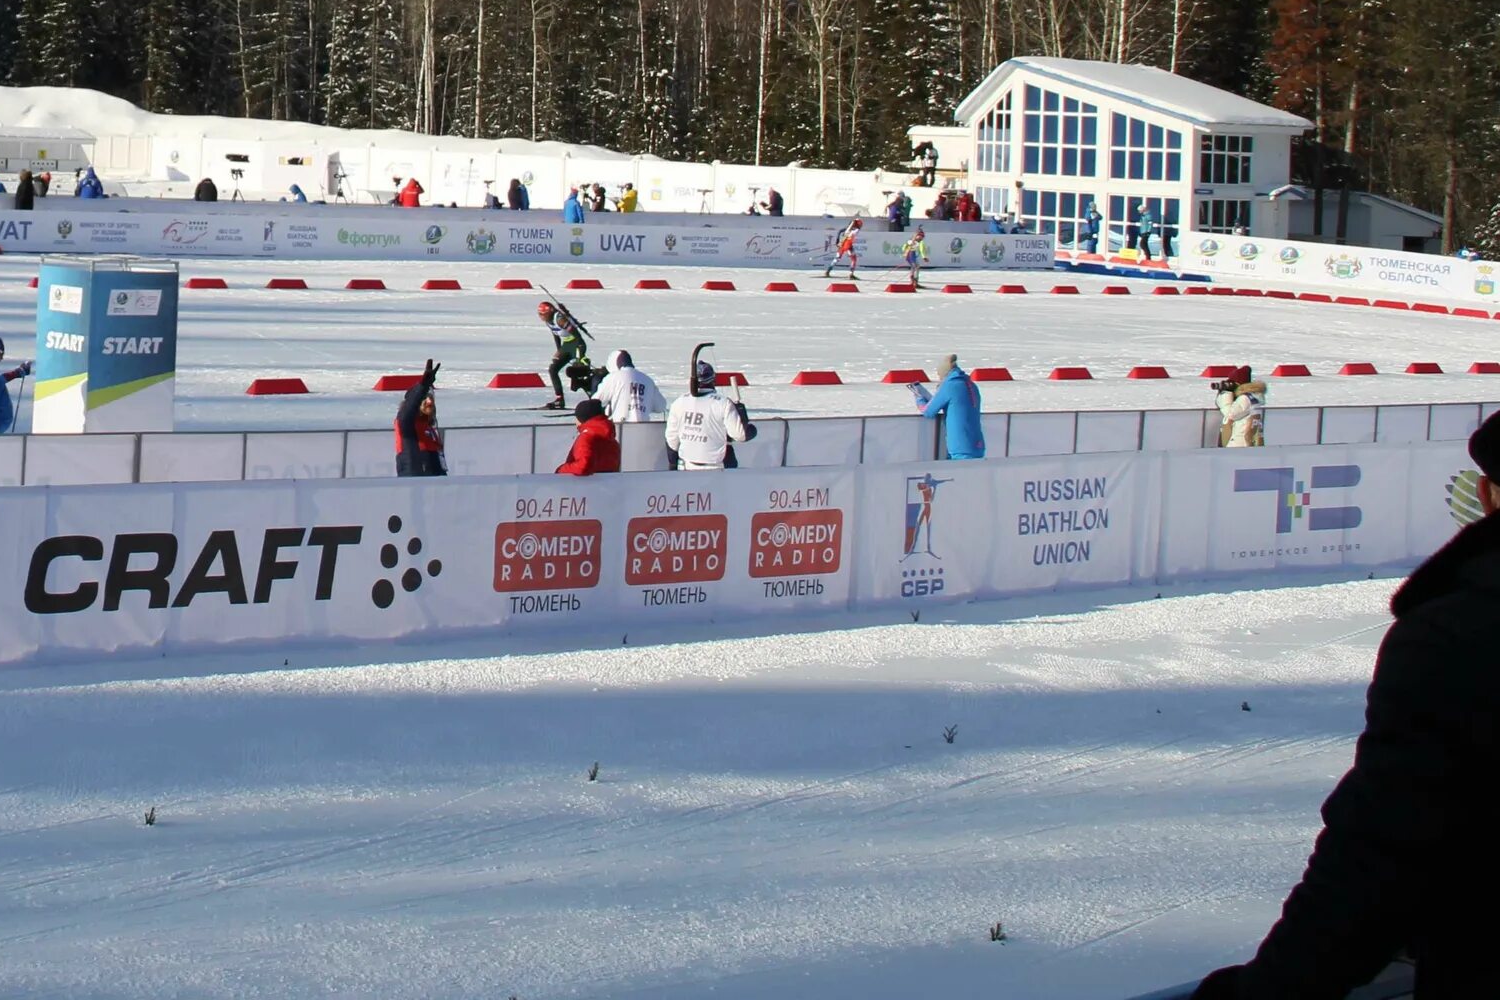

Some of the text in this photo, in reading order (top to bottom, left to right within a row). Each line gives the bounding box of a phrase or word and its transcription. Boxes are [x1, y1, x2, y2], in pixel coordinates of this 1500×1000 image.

[349, 228, 400, 248] фортум
[509, 228, 553, 239] TYUMEN
[600, 234, 646, 252] UVAT
[510, 243, 551, 254] REGION
[1014, 239, 1049, 249] TYUMEN
[1015, 252, 1048, 262] REGION
[1369, 256, 1451, 275] ТЮМЕНСКАЯ
[1379, 270, 1439, 286] ОБЛАСТЬ
[45, 331, 84, 352] START
[102, 337, 163, 355] START
[630, 382, 645, 395] HB
[684, 412, 704, 425] HB
[769, 488, 829, 509] 90.4 FM
[1024, 477, 1106, 503] RUSSIAN
[516, 497, 586, 518] 90.4 FM
[647, 492, 711, 514] 90.4 FM
[1019, 508, 1108, 535] BIATHLON
[633, 528, 721, 553] COMEDY
[757, 522, 836, 547] COMEDY
[501, 532, 595, 560] COMEDY
[1033, 540, 1090, 565] UNION
[1231, 543, 1362, 559] ТЮМЕНСКОЕ ВРЕМЯ
[632, 554, 719, 574] RADIO
[756, 547, 834, 567] RADIO
[24, 525, 363, 614] CRAFT
[501, 561, 593, 580] RADIO
[642, 586, 707, 607] ТЮМЕНЬ
[763, 578, 824, 598] ТЮМЕНЬ
[901, 578, 944, 598] СБР
[510, 593, 581, 614] ТЮМЕНЬ
